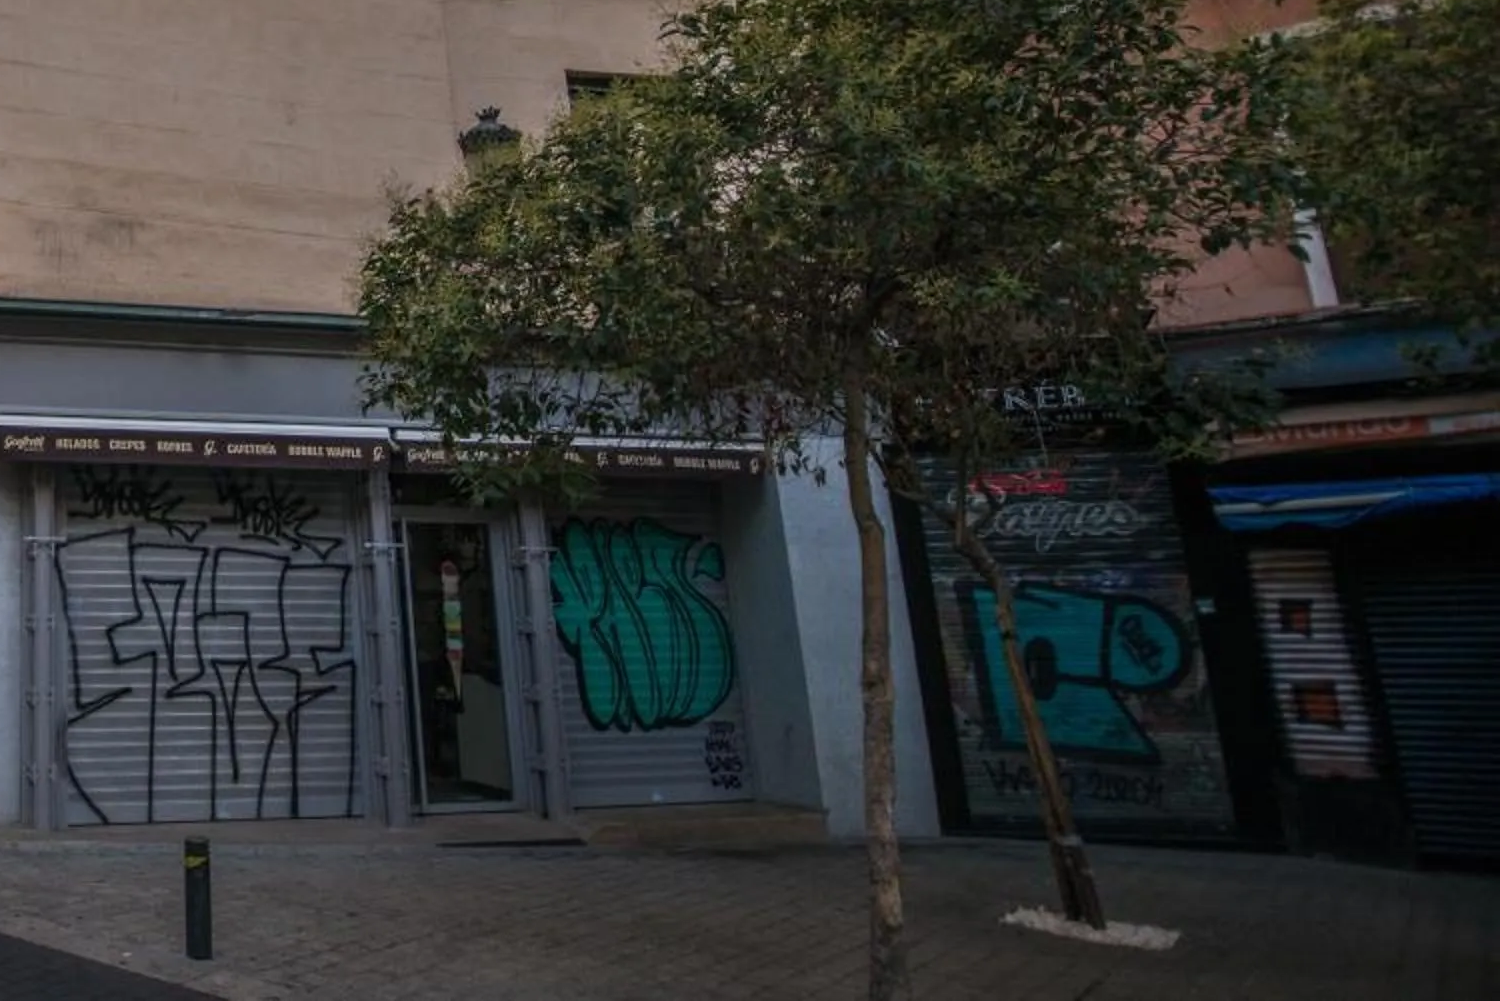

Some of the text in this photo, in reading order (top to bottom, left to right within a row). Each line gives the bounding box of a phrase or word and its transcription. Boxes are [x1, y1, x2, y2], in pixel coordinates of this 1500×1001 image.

[55, 438, 101, 452] HELADOS
[108, 439, 147, 452] CREPES
[156, 440, 194, 453] GOFRES
[288, 444, 324, 457] BUBBLE
[325, 446, 363, 459] WAFFLE
